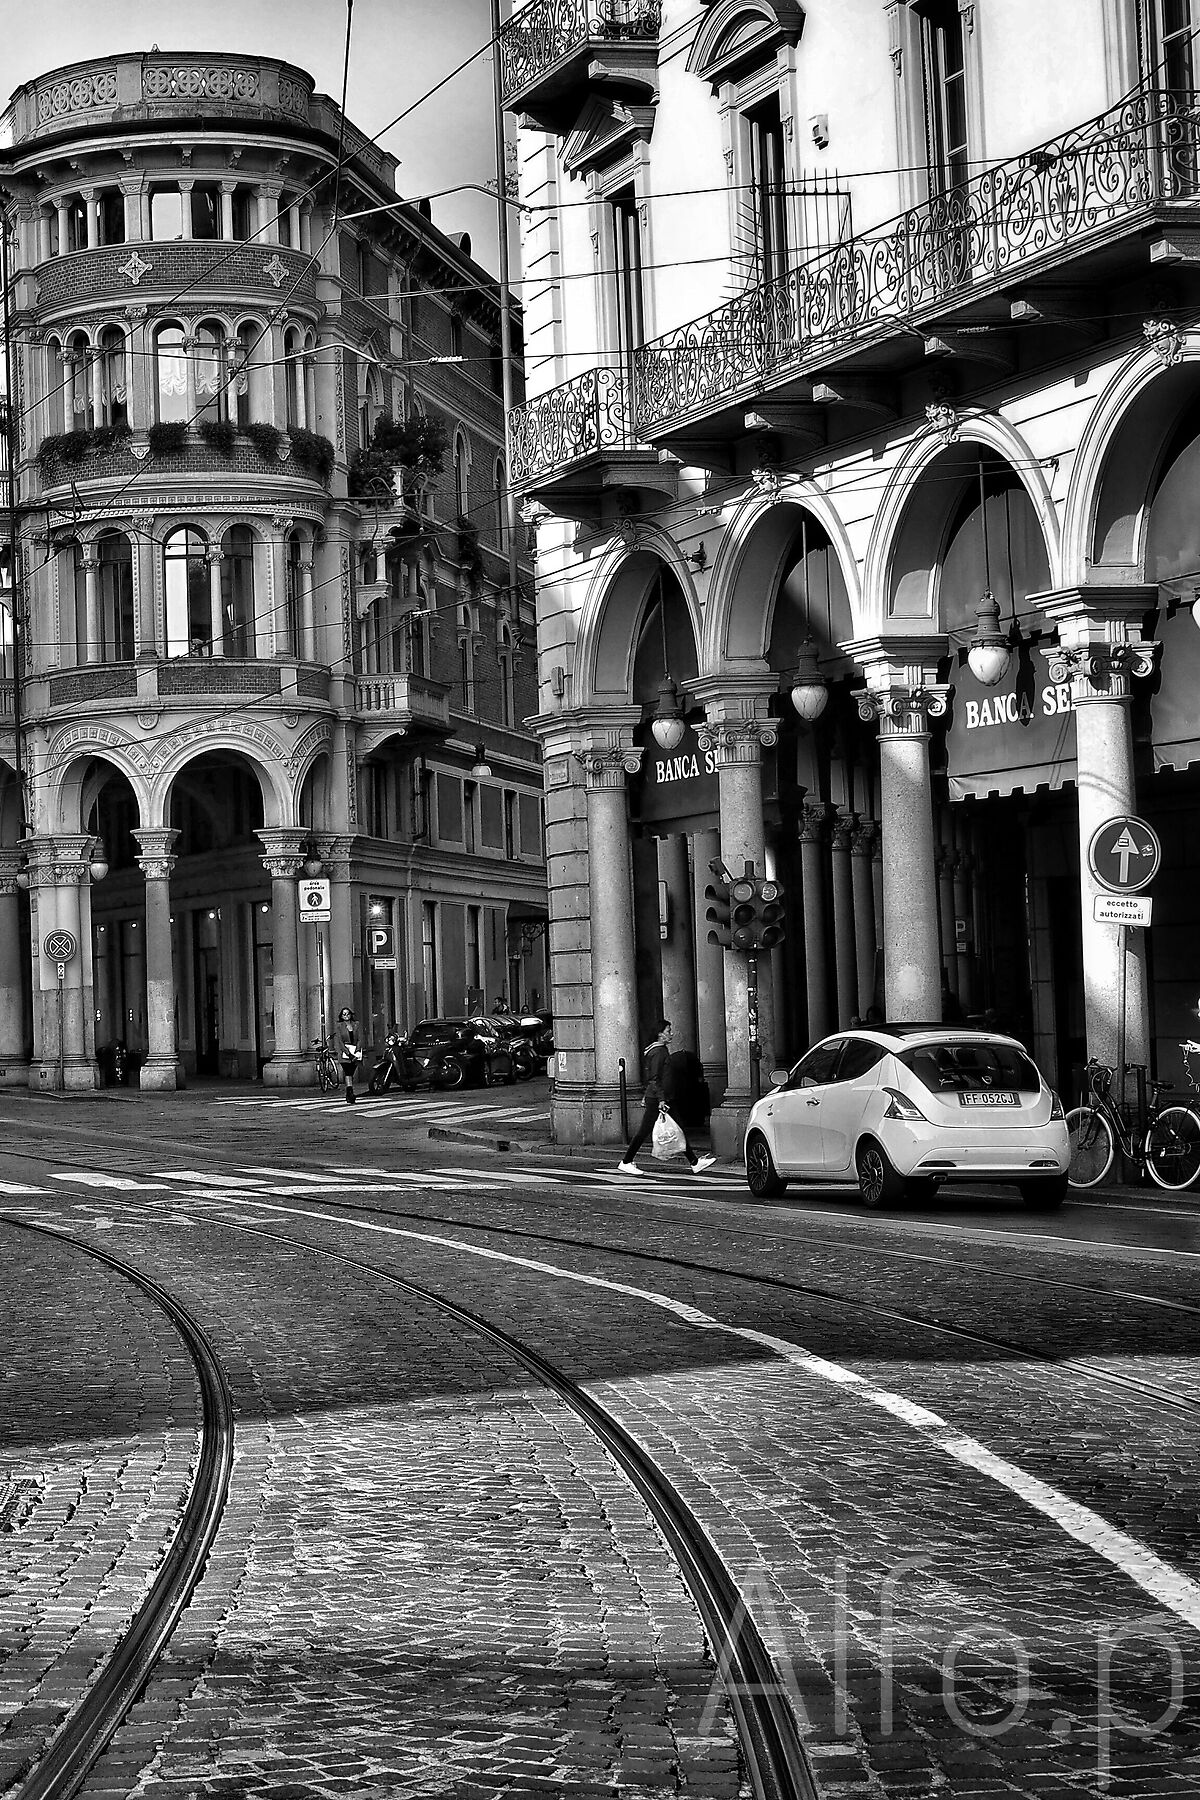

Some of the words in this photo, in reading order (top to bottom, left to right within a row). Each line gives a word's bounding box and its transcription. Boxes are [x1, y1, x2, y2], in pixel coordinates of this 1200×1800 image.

[965, 692, 1035, 729] BANCA
[655, 753, 700, 784] BANCA
[1099, 911, 1144, 920] autorizzati
[1106, 900, 1138, 908] eccetto
[371, 930, 388, 954] P
